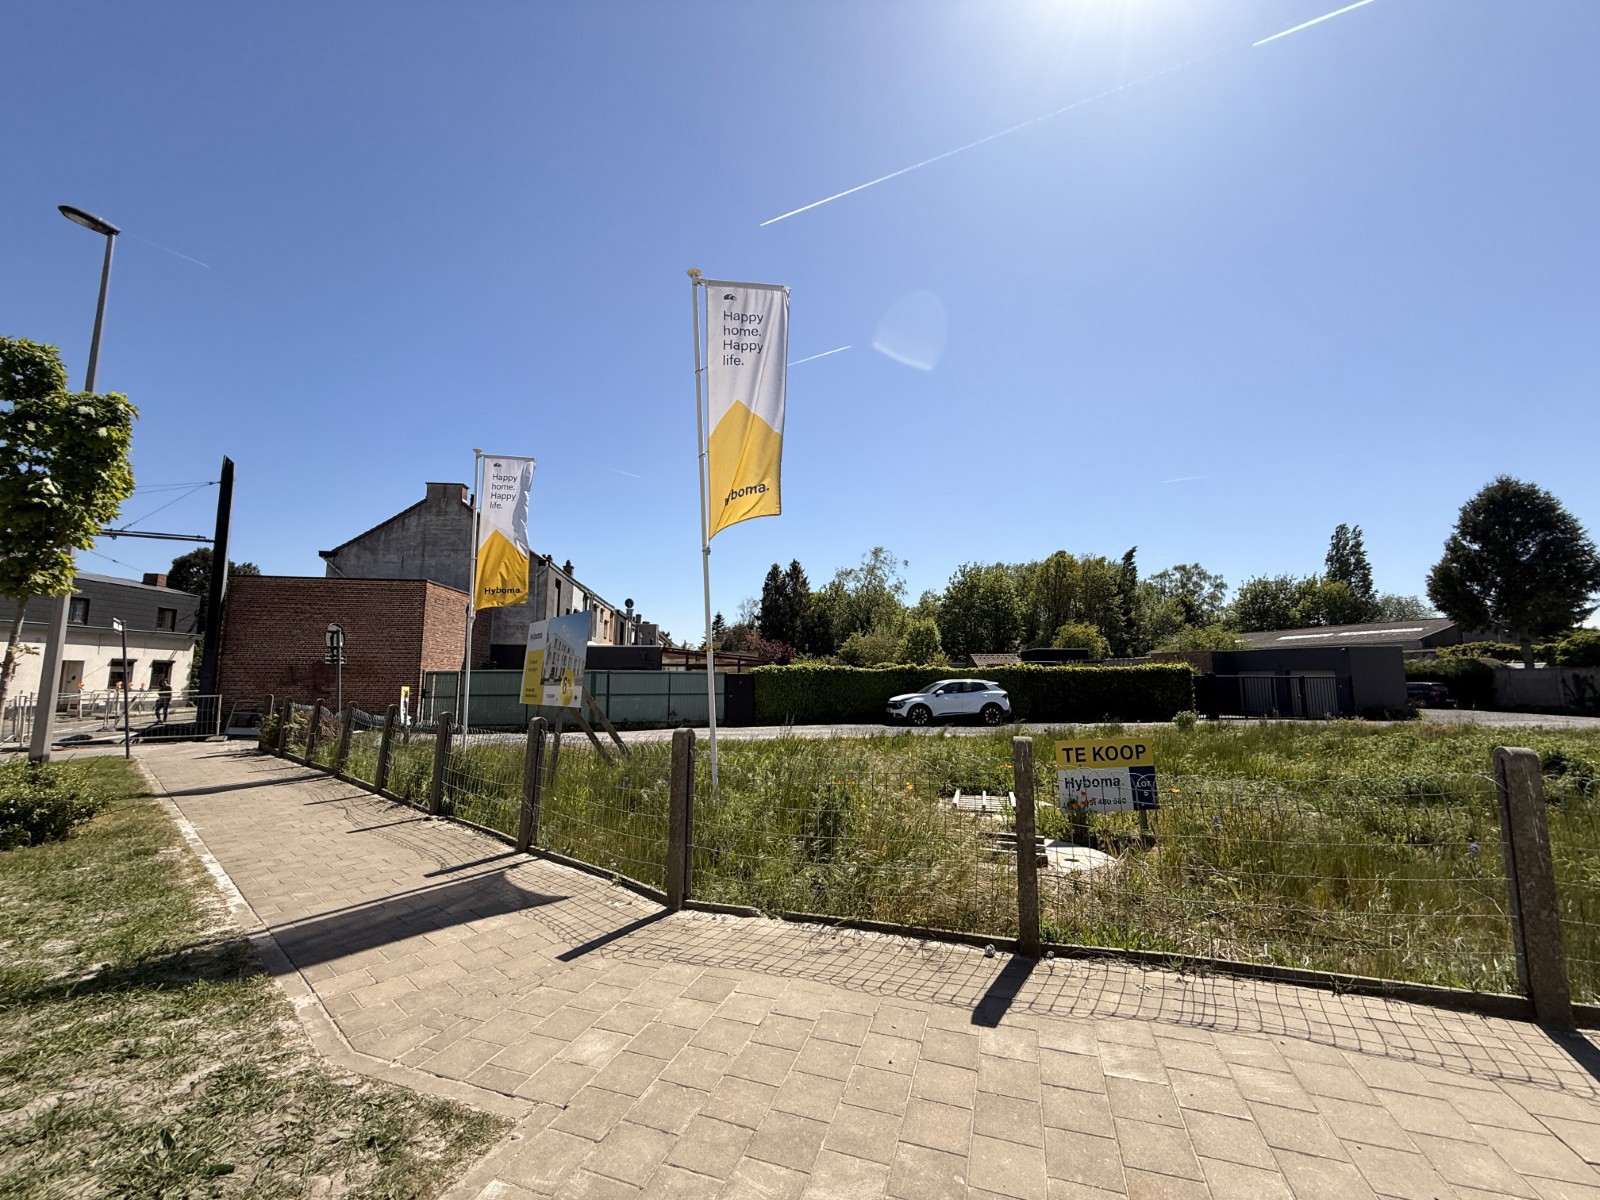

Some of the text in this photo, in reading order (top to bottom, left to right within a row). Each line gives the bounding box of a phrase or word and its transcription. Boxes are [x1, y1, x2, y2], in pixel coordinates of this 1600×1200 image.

[723, 310, 764, 324] Happy
[723, 325, 762, 337] home.
[723, 339, 764, 354] Happy
[722, 354, 744, 366] life.
[492, 474, 518, 482] Happy
[492, 482, 516, 490] home.
[490, 492, 516, 502] Happy
[724, 483, 770, 506] yboma.
[484, 586, 523, 596] Hyboma.
[1062, 744, 1146, 762] TE KOOP
